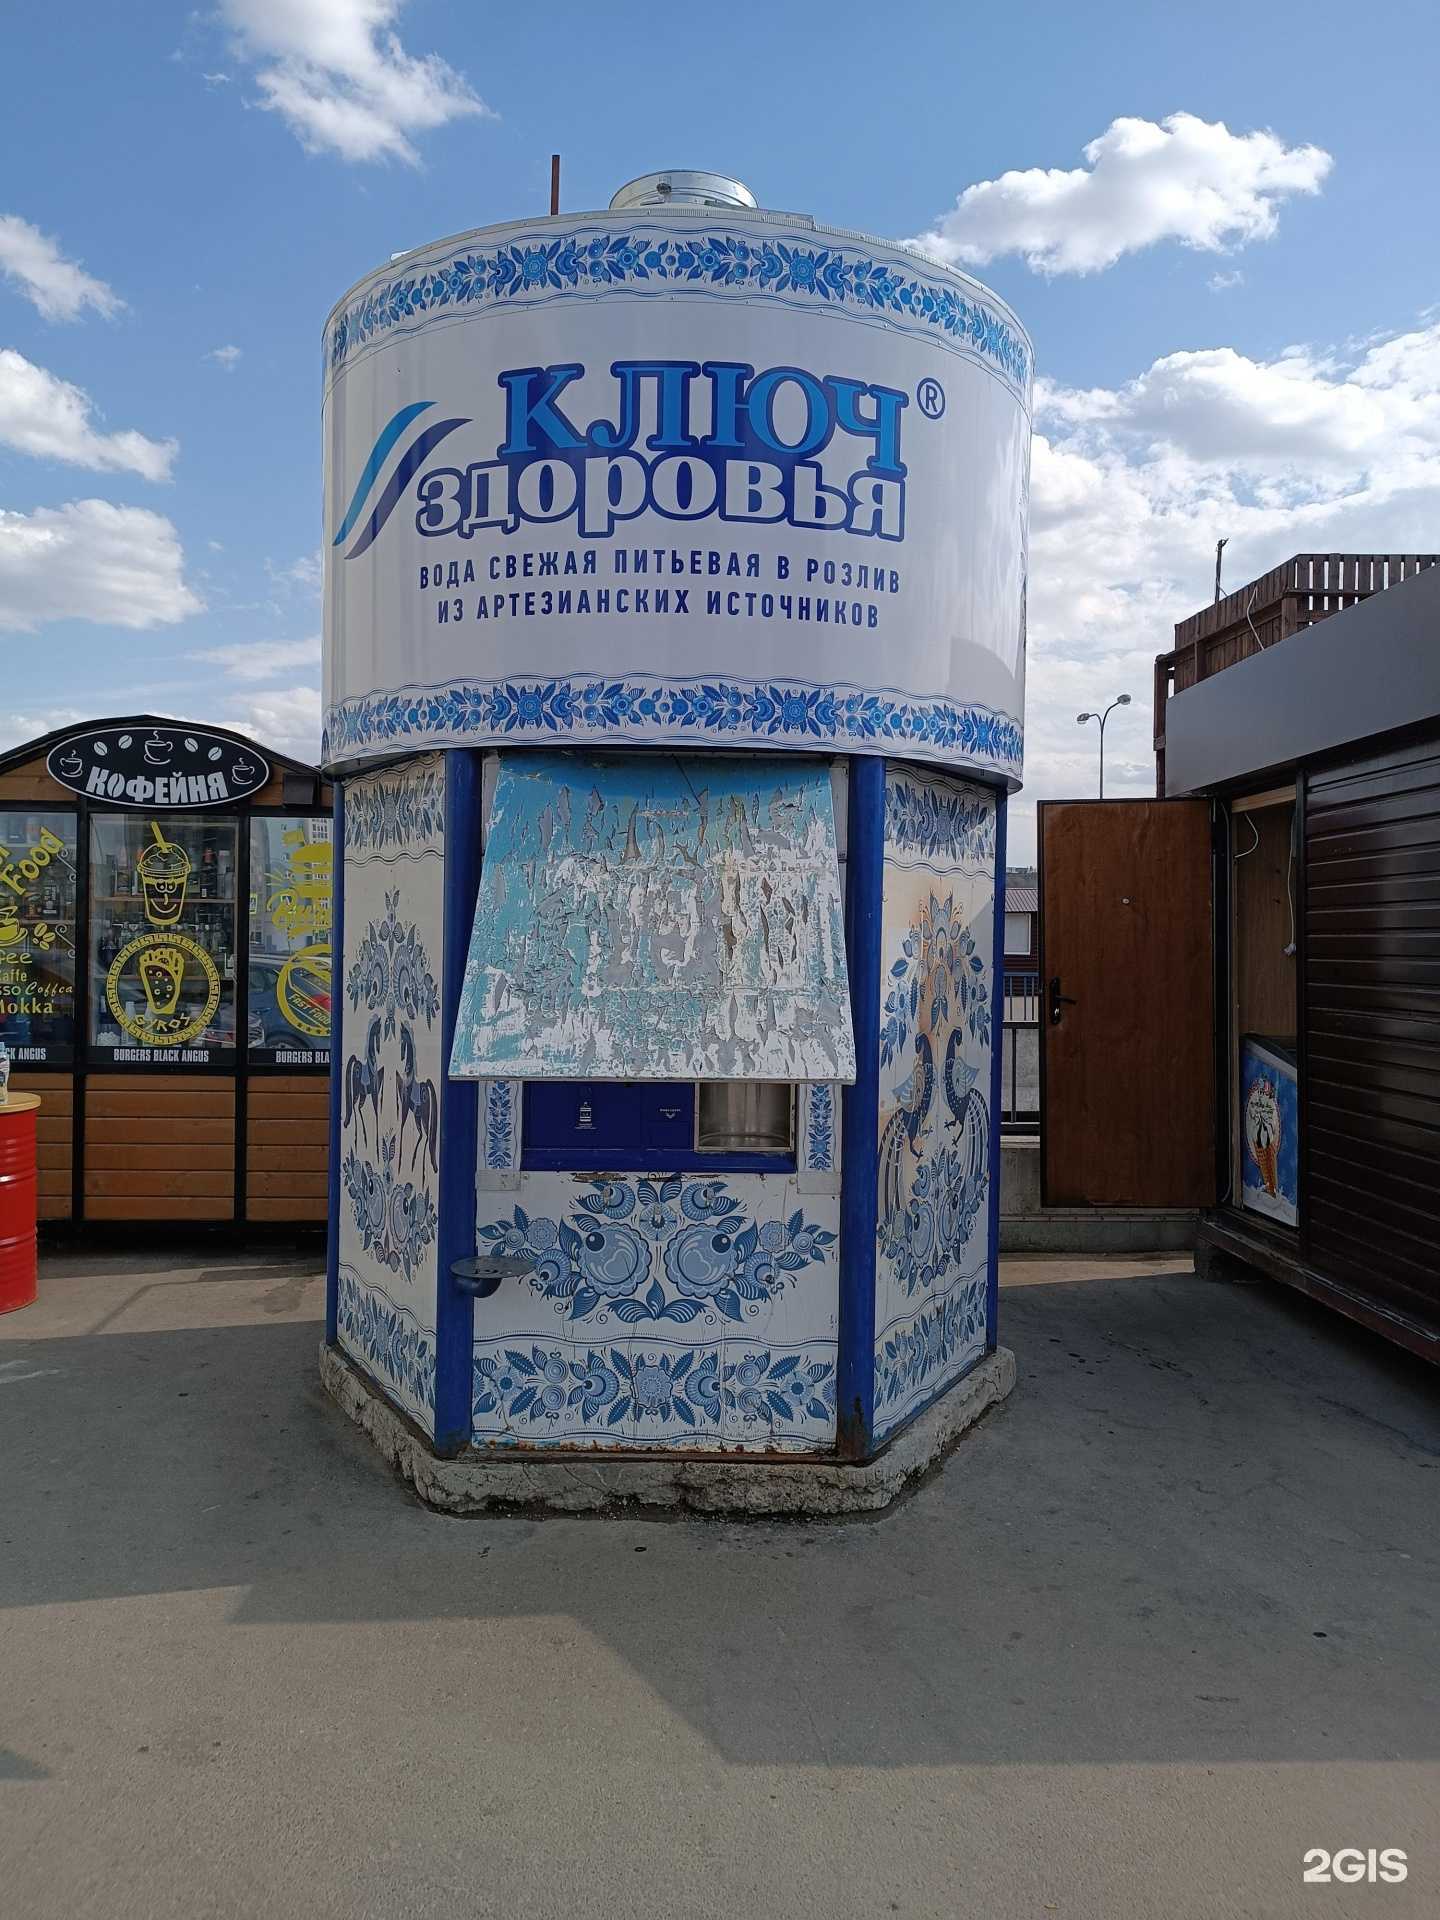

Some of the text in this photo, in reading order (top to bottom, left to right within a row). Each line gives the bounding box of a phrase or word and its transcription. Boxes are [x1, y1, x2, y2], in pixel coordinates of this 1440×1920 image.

[497, 360, 909, 480] КЛЮЧ
[420, 549, 899, 594] ВОДА СВЕЖАЯ ПИТЬЕВАЯ В РОЗЛИВ
[438, 588, 878, 628] ИЗ АРТЕЗИАНСКИХ ИСТОЧНИКОВ
[85, 765, 229, 804] КОФЕЙНЯ
[18, 1047, 47, 1061] ANGUS
[113, 1048, 209, 1063] BURGERS BLACK ANGUS
[275, 1050, 330, 1064] BURGERS BLA
